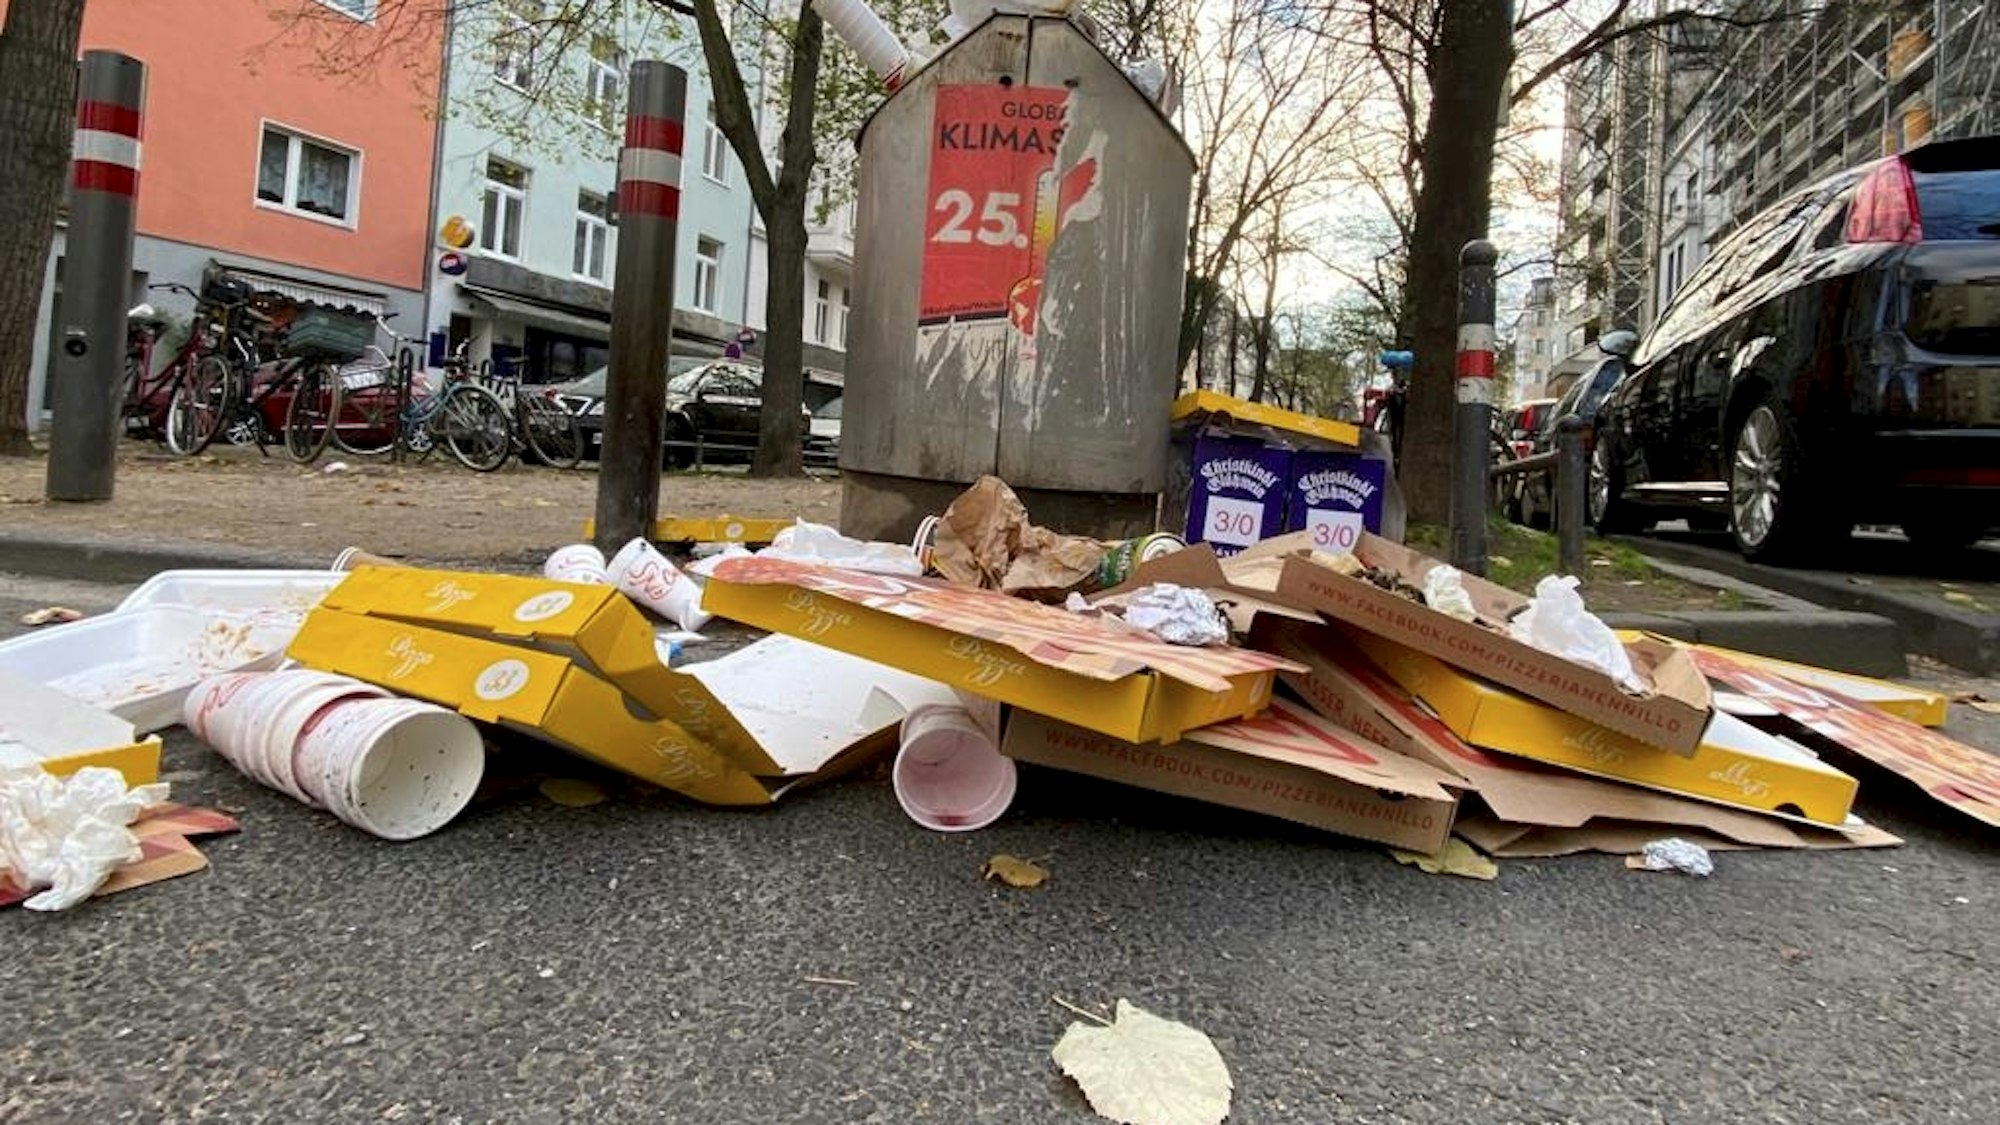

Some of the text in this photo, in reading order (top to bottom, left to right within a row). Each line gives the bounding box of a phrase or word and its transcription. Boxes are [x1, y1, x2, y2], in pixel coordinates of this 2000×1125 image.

[931, 188, 1028, 248] 25.
[1214, 510, 1254, 536] 3/0
[1314, 522, 1354, 548] 3/0
[784, 589, 851, 636] Pizza
[946, 635, 1027, 686] Pizza
